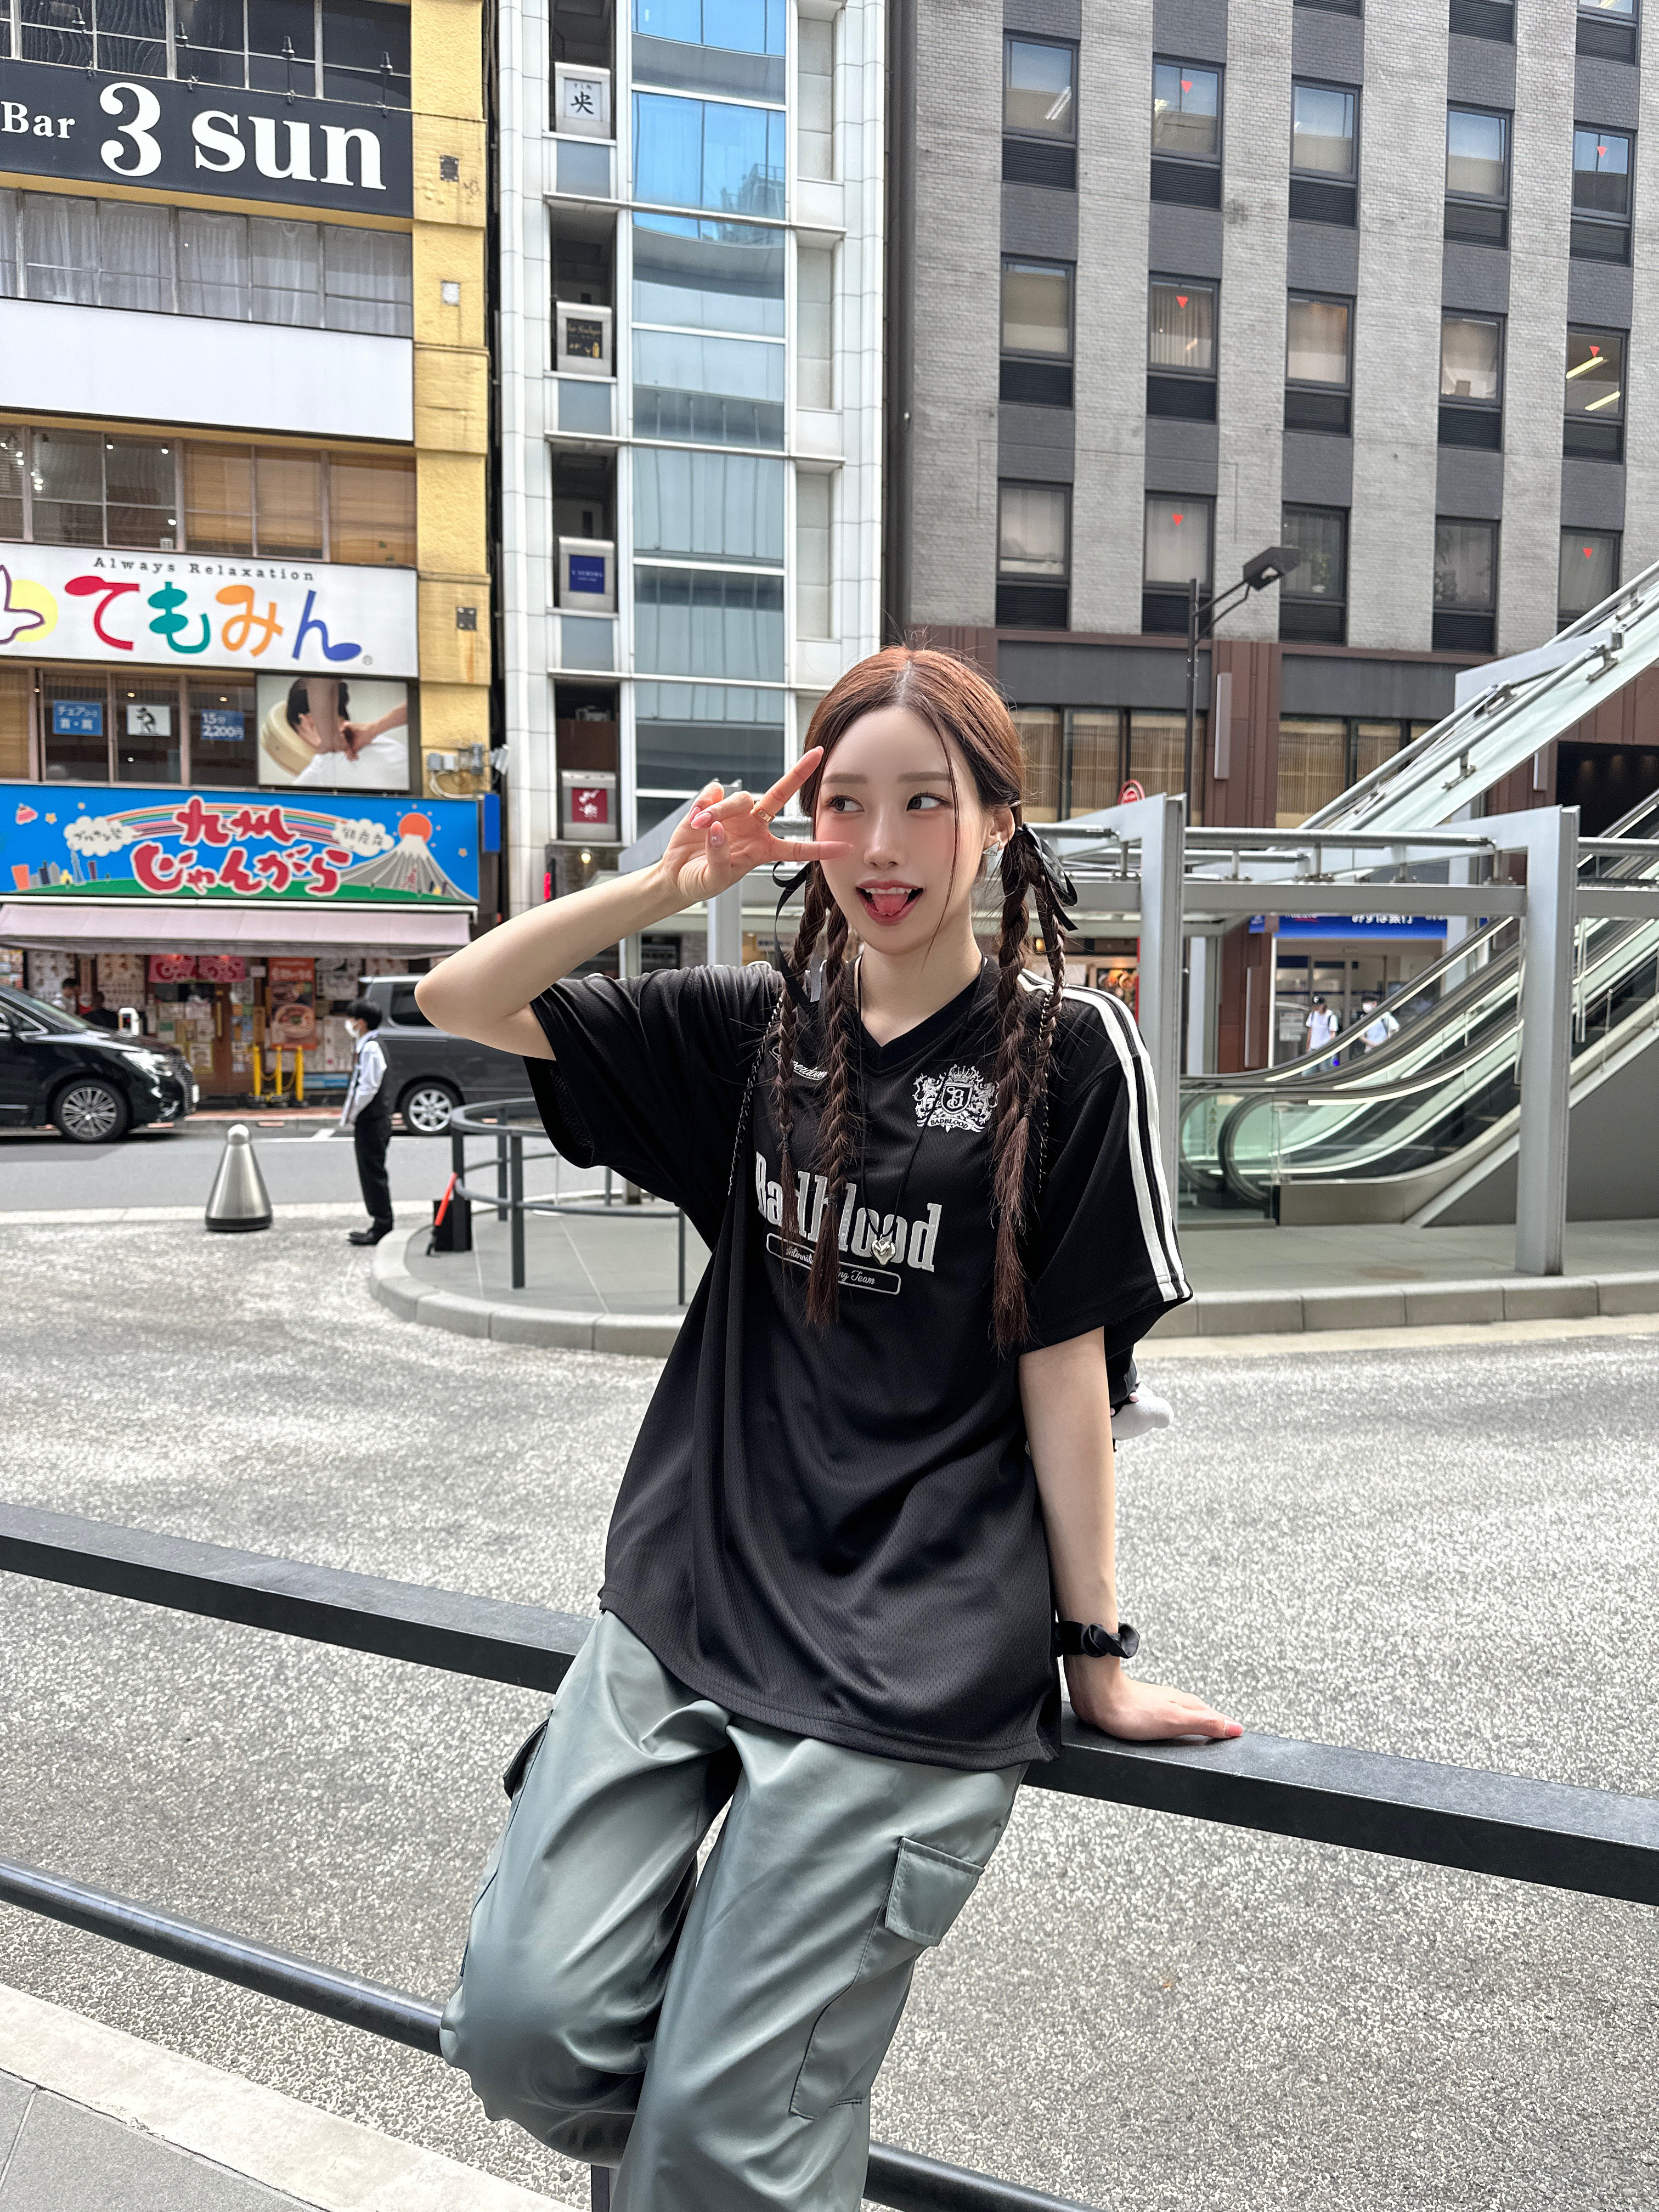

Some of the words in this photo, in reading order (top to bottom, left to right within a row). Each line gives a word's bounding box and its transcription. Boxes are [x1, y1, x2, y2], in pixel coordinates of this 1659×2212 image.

[571, 91, 594, 115] 央
[1, 101, 76, 139] Bar
[99, 82, 162, 177] 3
[191, 110, 386, 190] sun
[94, 557, 176, 574] Always
[189, 563, 314, 581] Relaxation
[64, 575, 362, 662] てもみん
[174, 797, 298, 845] 九州
[132, 843, 352, 895] じゃんがら
[930, 1118, 969, 1129] BADBLOOD
[851, 1269, 876, 1285] Team
